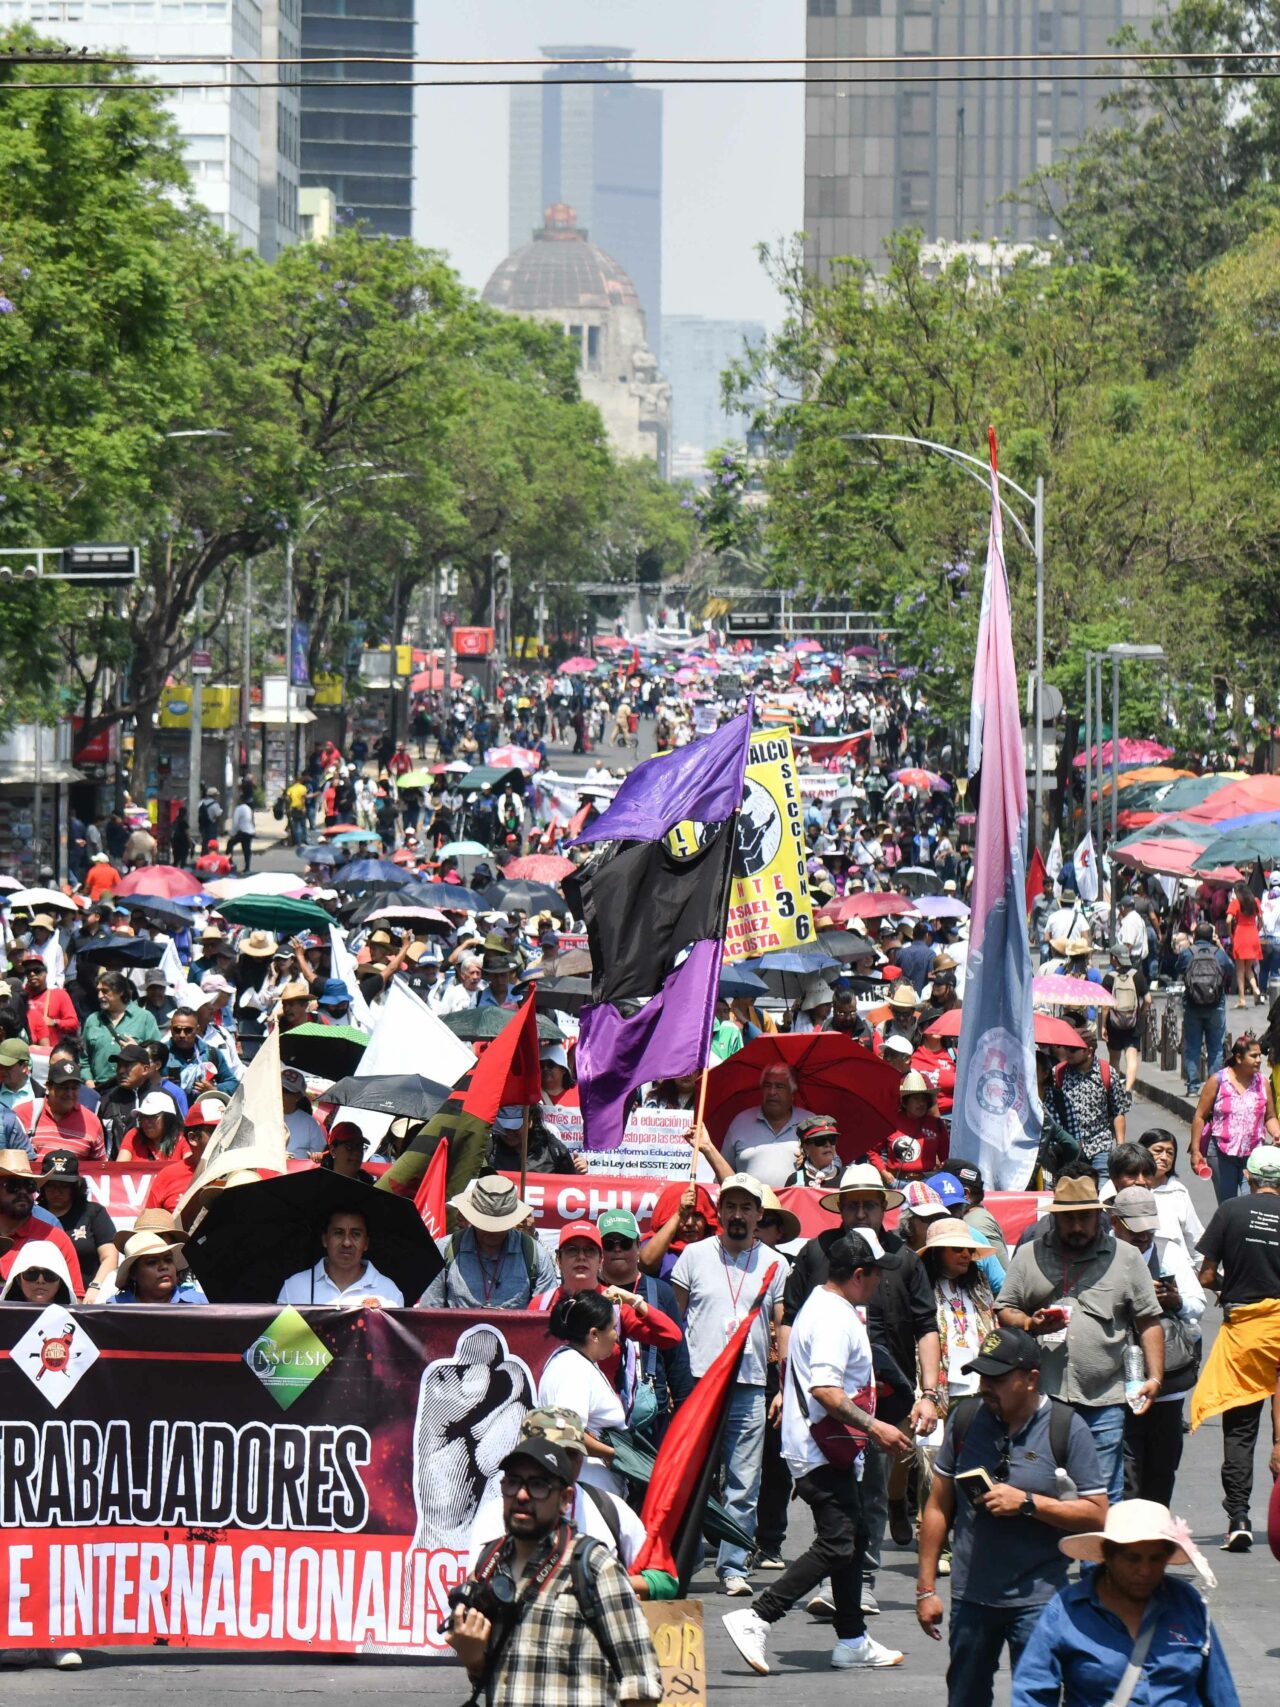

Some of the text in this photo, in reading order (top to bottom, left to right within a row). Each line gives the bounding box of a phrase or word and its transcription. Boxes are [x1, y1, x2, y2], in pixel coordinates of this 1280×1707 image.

[590, 1159, 601, 1167] de
[610, 1160, 625, 1170] Ley
[625, 1160, 639, 1168] del
[639, 1161, 669, 1169] ISSSTE
[669, 1163, 691, 1171] 2007
[941, 1180, 957, 1194] LA
[7, 1544, 34, 1637] E
[48, 1544, 468, 1647] INTERNACIONALIS
